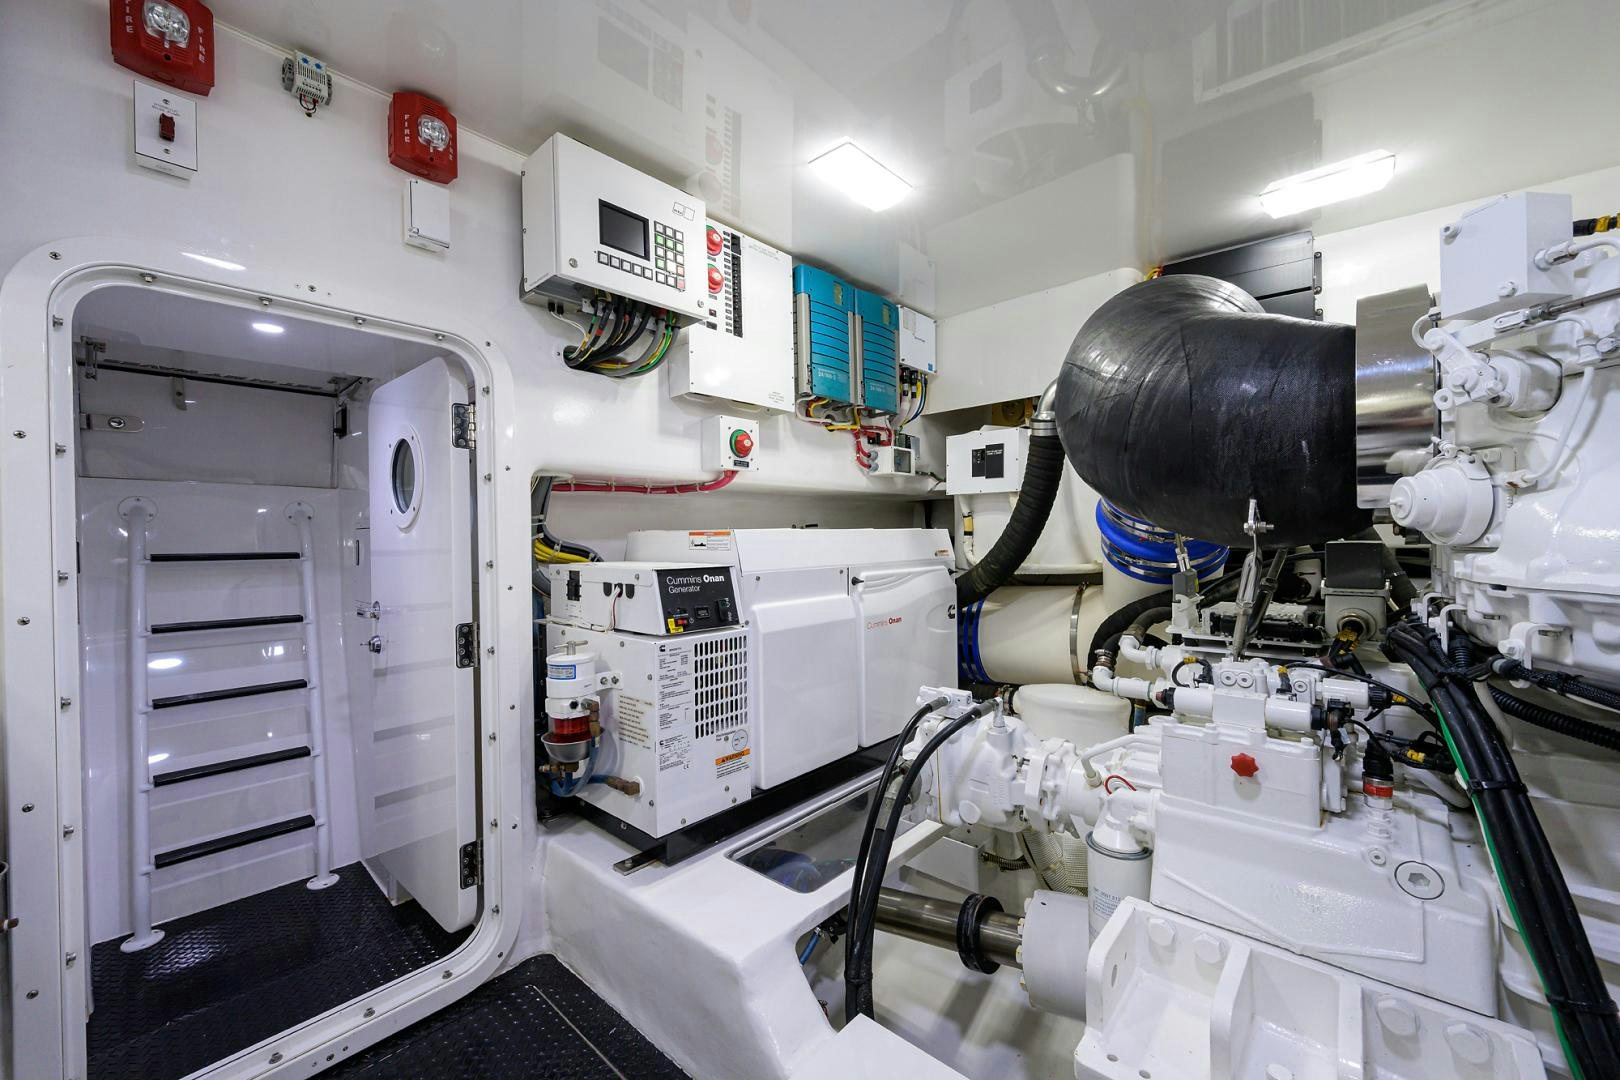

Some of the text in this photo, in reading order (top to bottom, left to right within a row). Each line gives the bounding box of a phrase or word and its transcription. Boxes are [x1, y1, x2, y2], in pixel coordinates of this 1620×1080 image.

[197, 26, 207, 63] FIRE
[666, 574, 725, 585] Cummins Onan
[668, 585, 701, 594] Generator
[888, 617, 903, 625] Onan
